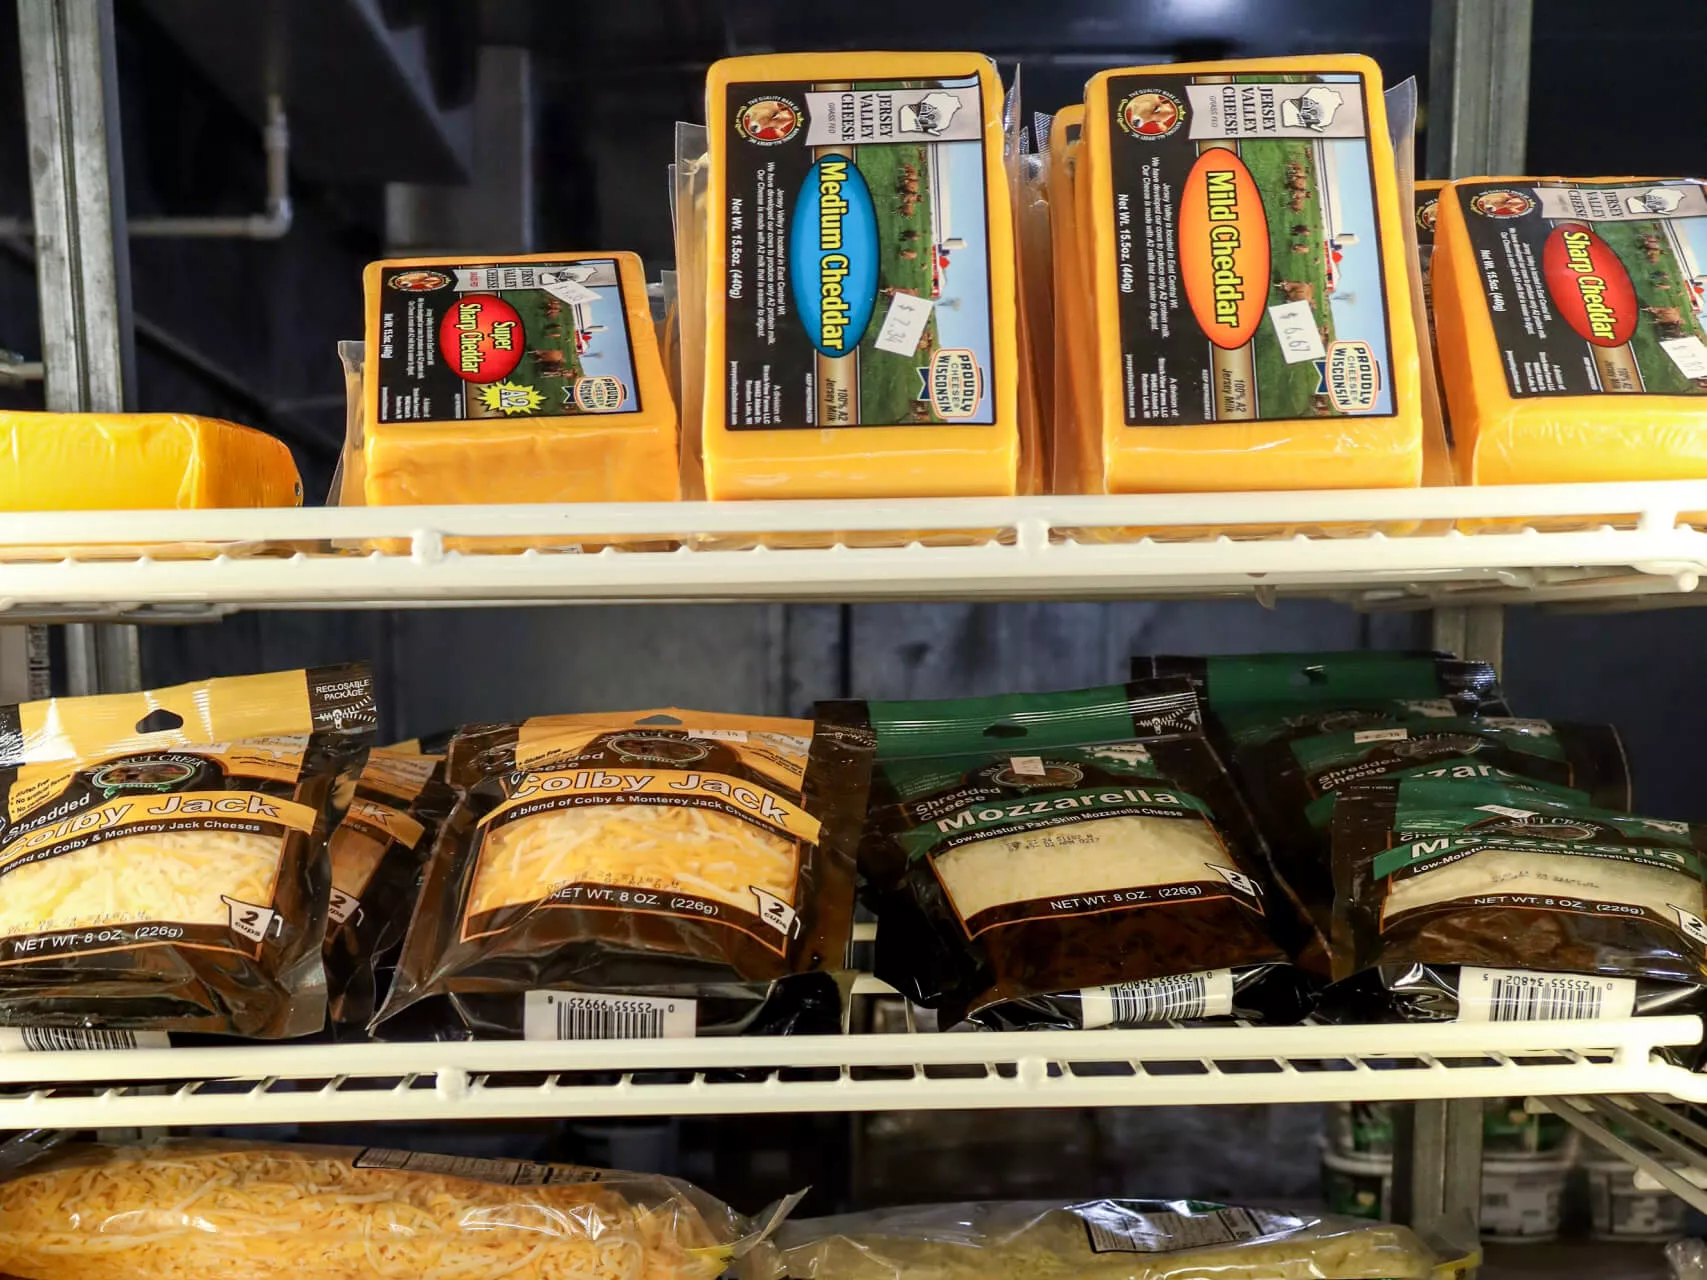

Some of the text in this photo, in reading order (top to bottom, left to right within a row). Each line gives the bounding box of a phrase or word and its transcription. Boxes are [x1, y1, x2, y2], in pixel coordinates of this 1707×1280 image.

[841, 94, 855, 141] CHEESE
[861, 94, 874, 139] VALLEY
[876, 93, 893, 138] JERSEY
[1222, 86, 1238, 136] CHEESE
[1242, 87, 1257, 134] VALLEY
[1257, 86, 1276, 132] JERSEY
[1568, 190, 1588, 219] CHEESE
[1586, 192, 1606, 219] VALLEY
[1600, 191, 1624, 218] JERSEY
[729, 198, 742, 299] Net Wt. 15.5oz. (440g)
[820, 162, 849, 350] Medium Cheddar
[1118, 194, 1134, 293] Net Wt. 15.5oz. (440g)
[1206, 171, 1244, 328] Mild Cheddar
[487, 268, 500, 289] CHEESE
[504, 269, 517, 288] VALLEY
[521, 268, 535, 287] JERSEY
[1564, 231, 1616, 340] Sharp Cheddar
[456, 304, 484, 374] Sharp Cheddar
[489, 322, 516, 350] Super
[936, 355, 952, 412] WISCONSIN
[958, 355, 975, 412] PROUDLY
[1332, 348, 1350, 406] WISCONSIN
[1354, 347, 1372, 405] PROUDLY
[501, 389, 530, 407] A2
[825, 379, 837, 422] Jersey Milk
[837, 388, 849, 422] 100% A2
[315, 679, 370, 694] RECLOSABLE
[324, 688, 365, 700] PACKAGE
[8, 793, 91, 835] Shredded
[510, 771, 790, 826] Colby Jack
[916, 787, 1000, 815] Shredded
[936, 789, 1181, 833] Mozzarella
[0, 794, 281, 858] Colby Jack
[37, 849, 50, 860] of
[53, 837, 90, 855] Colby
[92, 832, 102, 842] &
[105, 823, 166, 839] Monterey
[169, 821, 200, 831] Jack
[203, 820, 260, 832] Cheeses
[948, 808, 1184, 847] Low-Moisture Part-Skim Mozzarella Cheese
[240, 910, 260, 927] 2
[550, 887, 718, 916] NET WT. 8 OZ. (226g)
[768, 902, 786, 918] 2
[1050, 886, 1202, 911] NET WT. 8 OZ. (226g)
[1474, 896, 1506, 906] NET
[1512, 896, 1541, 905] WT.
[1545, 898, 1554, 906] 8
[1596, 902, 1645, 916] (226g)
[14, 936, 47, 952] NET
[51, 934, 79, 948] WT.
[83, 932, 94, 943] 8
[134, 926, 184, 940] (226g)
